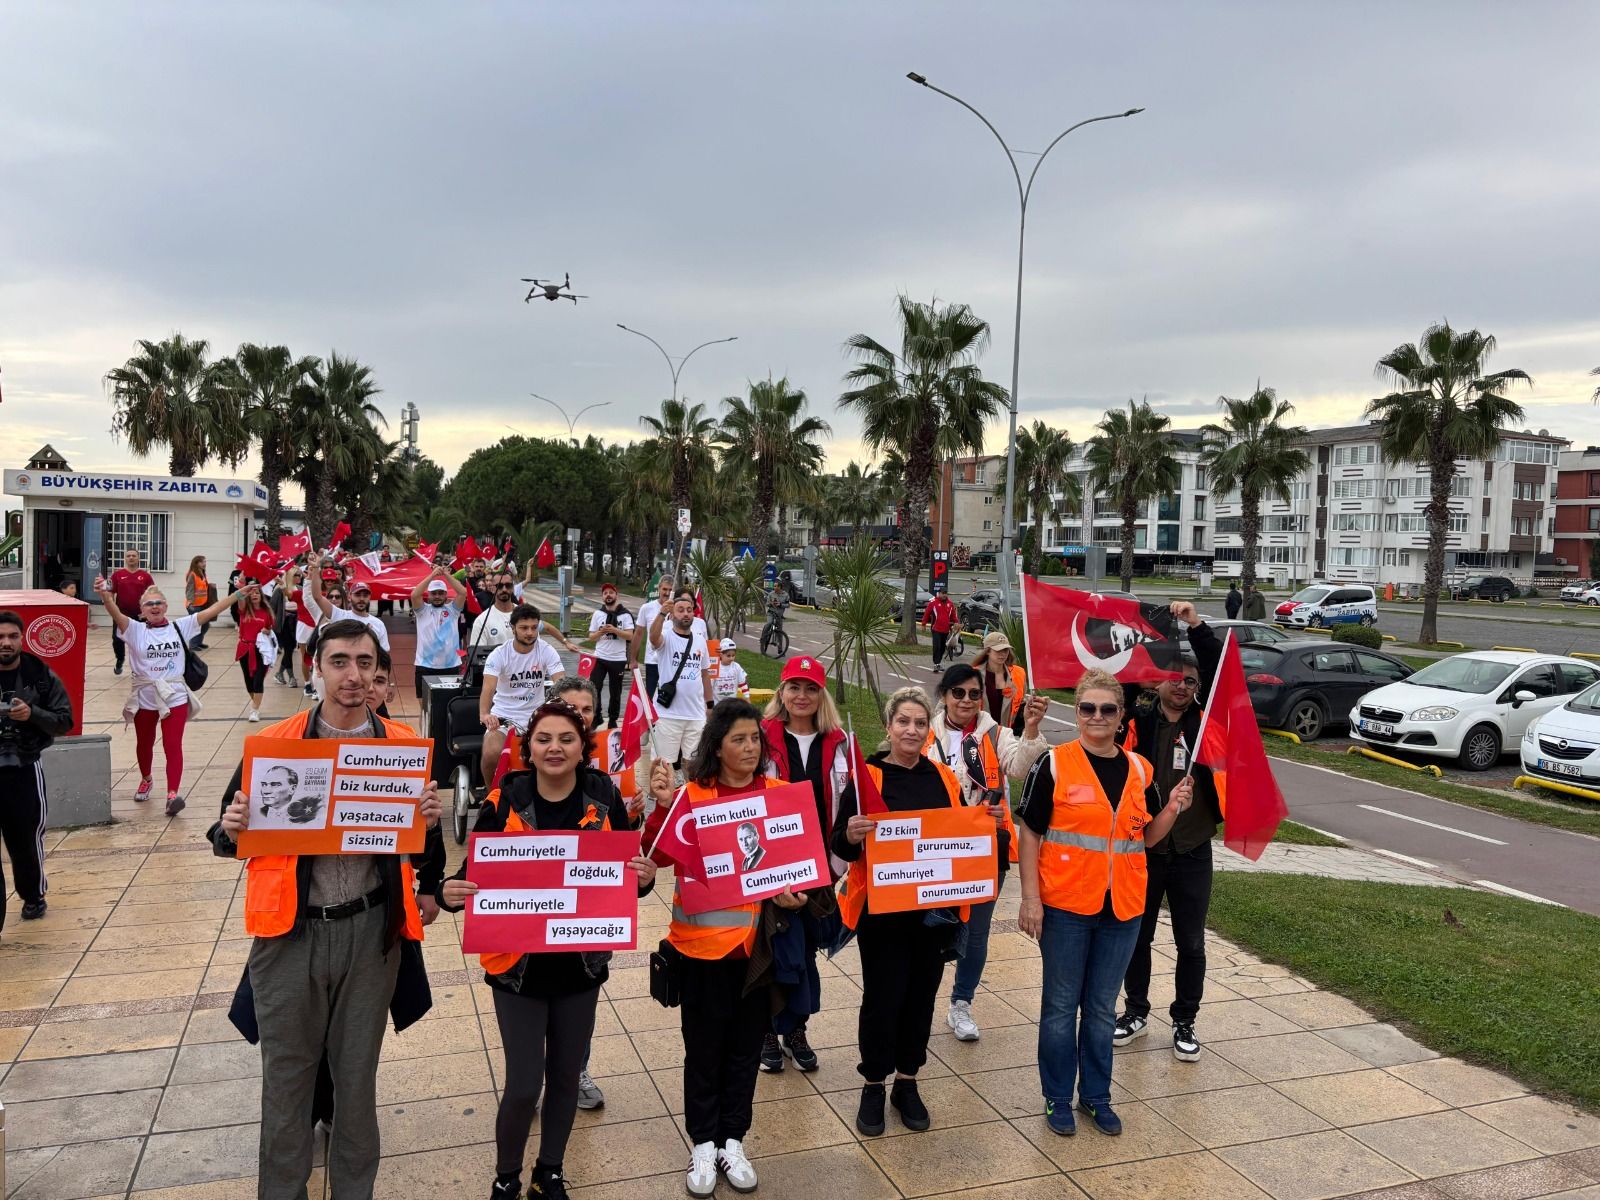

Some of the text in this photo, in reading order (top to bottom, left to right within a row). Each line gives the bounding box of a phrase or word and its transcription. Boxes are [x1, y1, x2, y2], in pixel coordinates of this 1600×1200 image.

[41, 475, 218, 493] BÜYÜKŞEHİR ZABITA
[510, 670, 542, 681] ATAM
[344, 754, 425, 768] Cumhuriyeti
[1552, 763, 1560, 771] BS
[340, 780, 413, 795] biz kurduk,
[340, 810, 404, 823] yaşatacak
[700, 813, 727, 825] Ekim
[729, 807, 757, 820] kutlu
[770, 822, 798, 834] olsun
[880, 826, 918, 836] 29 Ekim
[348, 833, 394, 847] sizsiniz
[480, 845, 566, 859] Cumhuriyetle
[917, 842, 974, 853] gururumuz,
[569, 866, 619, 880] doğduk,
[706, 863, 729, 875] asın
[877, 868, 934, 881] Cumhuriyet
[746, 865, 812, 888] Cumhuriyet!
[921, 884, 986, 898] onurumuzdur
[479, 898, 565, 912] Cumhuriyetle
[551, 923, 624, 937] yaşayacağız
